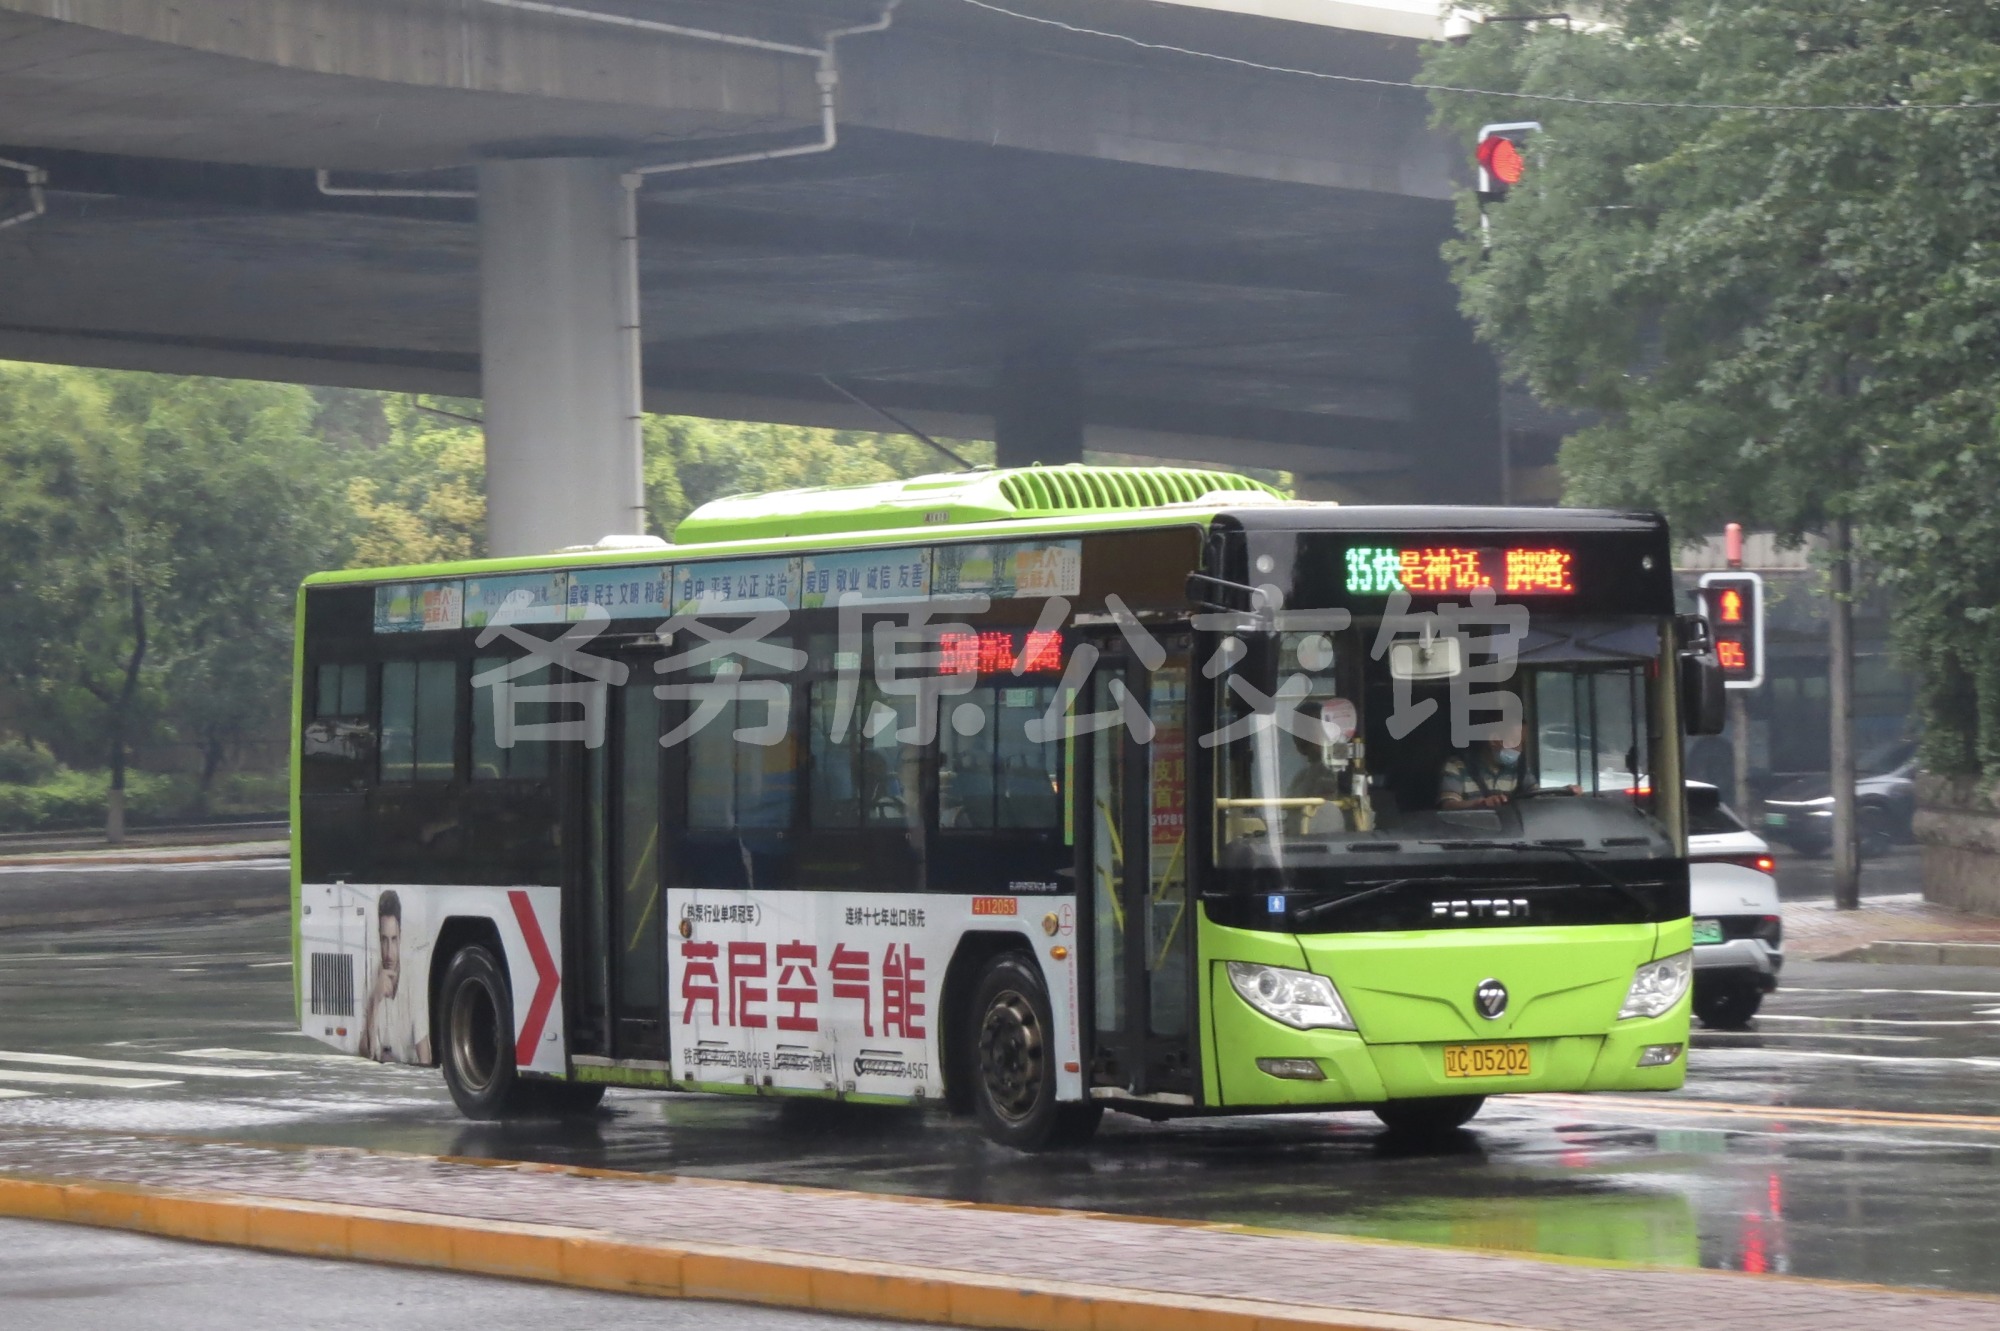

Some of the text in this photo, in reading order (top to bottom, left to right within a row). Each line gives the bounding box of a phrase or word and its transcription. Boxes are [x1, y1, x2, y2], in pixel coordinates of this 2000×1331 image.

[737, 574, 759, 598] 公正
[806, 569, 829, 593] 爱国
[836, 568, 860, 592] 敬业
[897, 563, 923, 588] 友善
[619, 582, 639, 605] 文明
[845, 907, 926, 928] 连续十七年出口领先
[1430, 898, 1530, 918] FOTON
[681, 939, 926, 1039] 芬尼空气能
